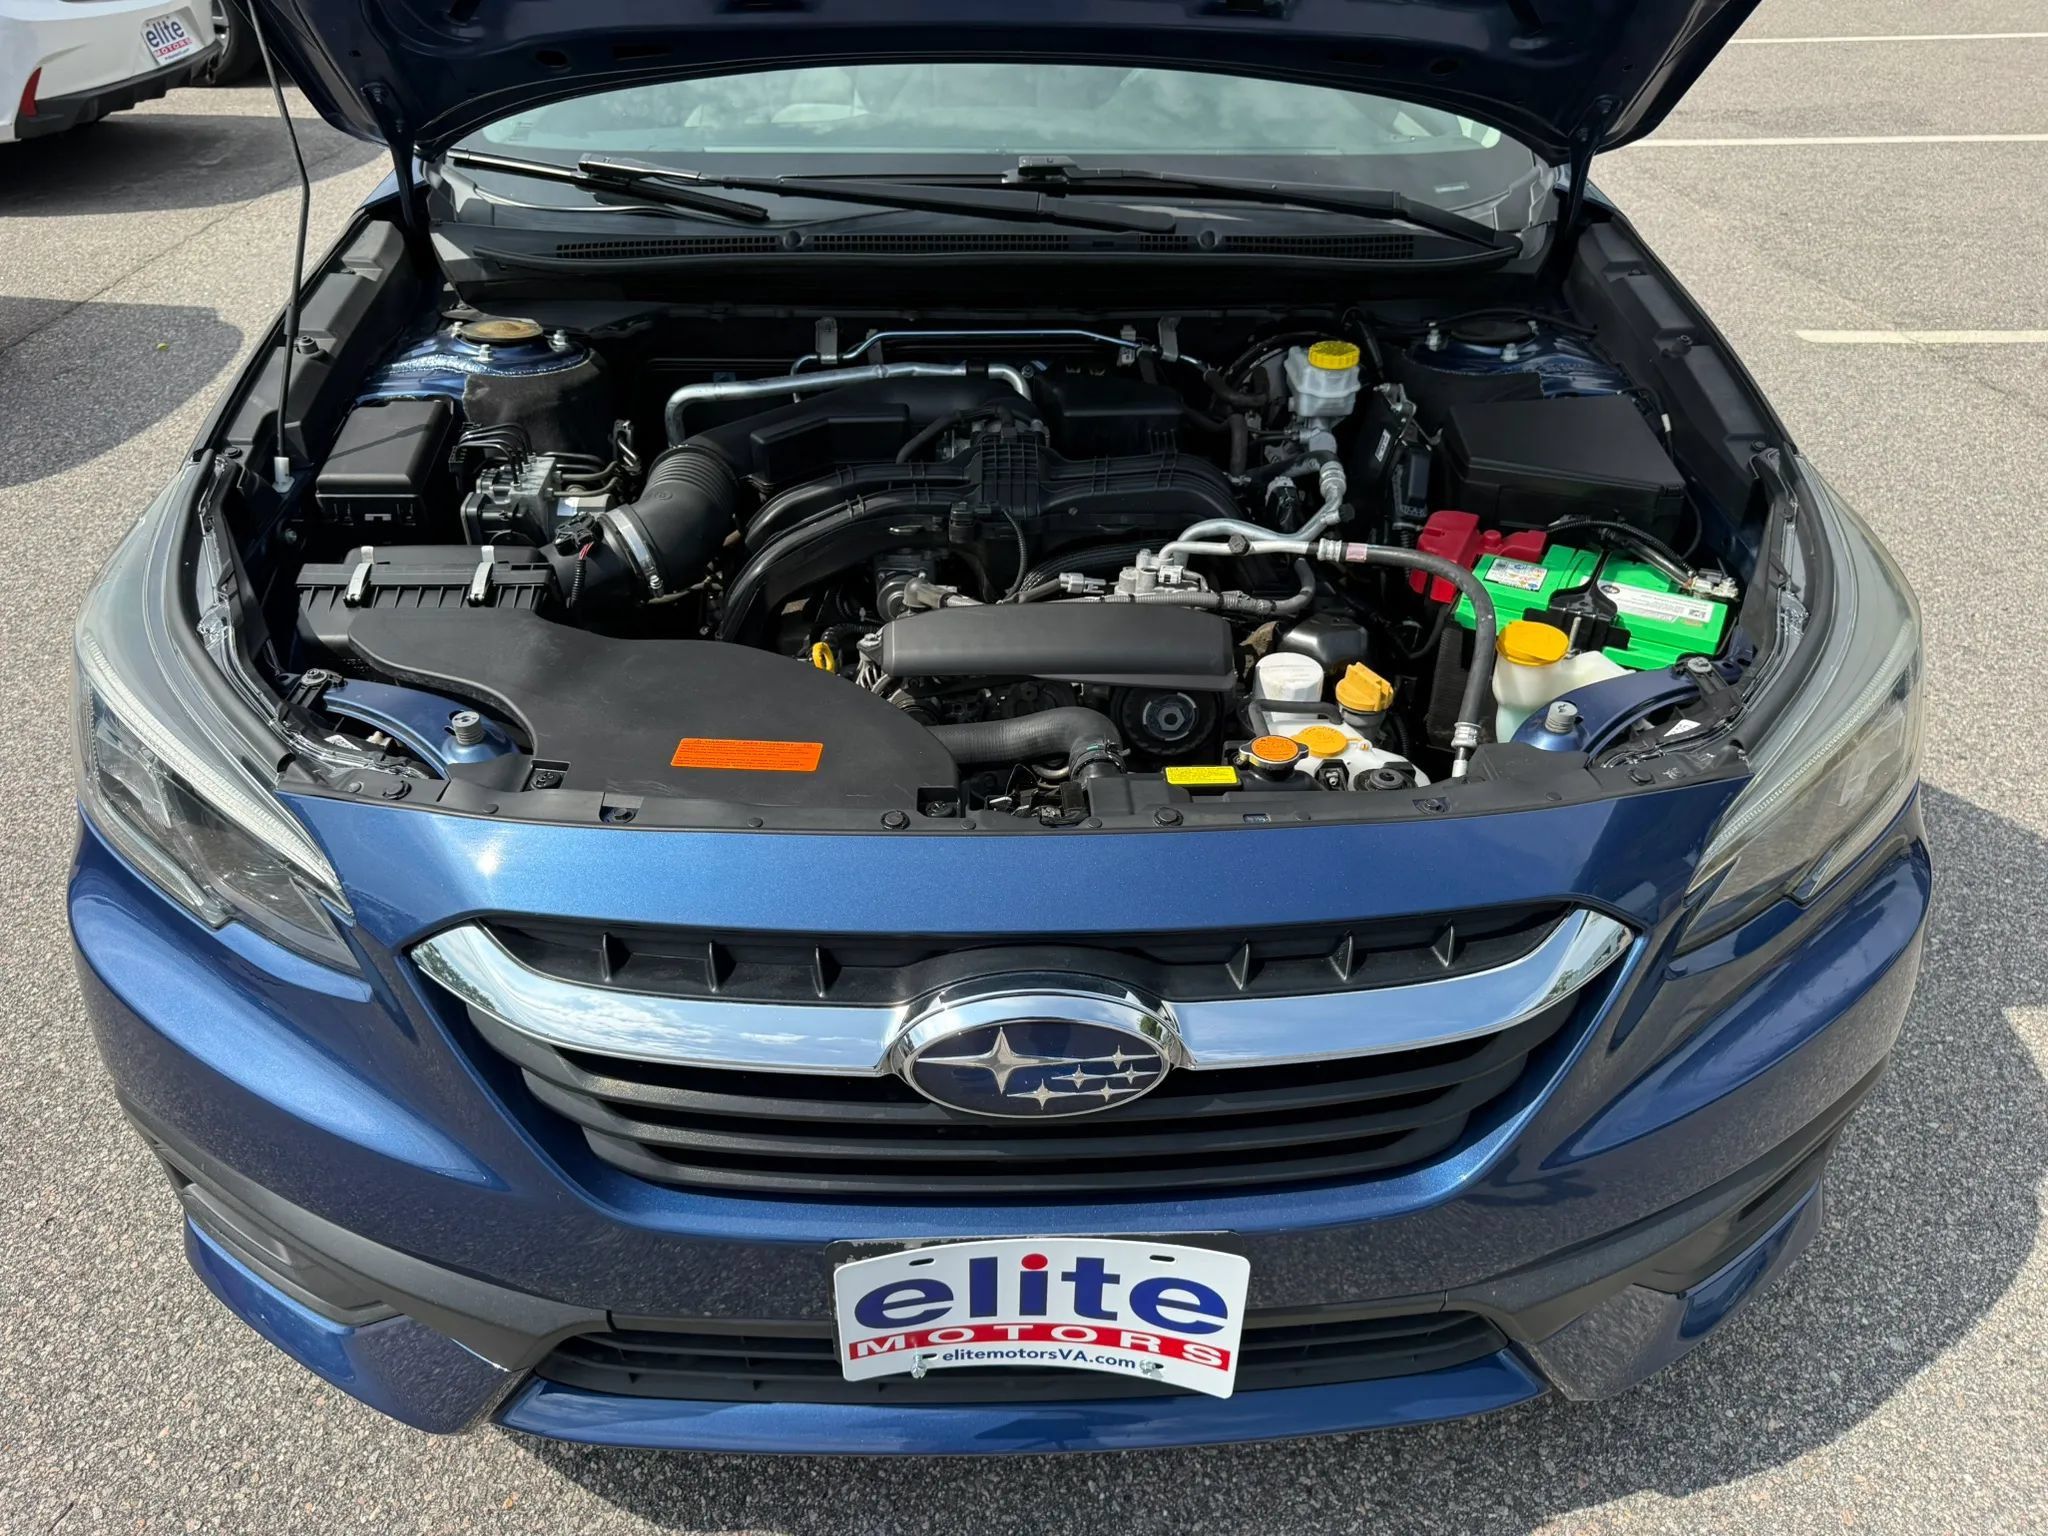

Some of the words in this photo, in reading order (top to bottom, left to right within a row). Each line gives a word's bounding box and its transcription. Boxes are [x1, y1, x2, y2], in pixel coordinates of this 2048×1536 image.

[146, 21, 184, 47] elite
[854, 1253, 1228, 1334] elite
[856, 1324, 1224, 1367] MOTORS
[942, 1347, 1136, 1370] elitemotorsVA.com
